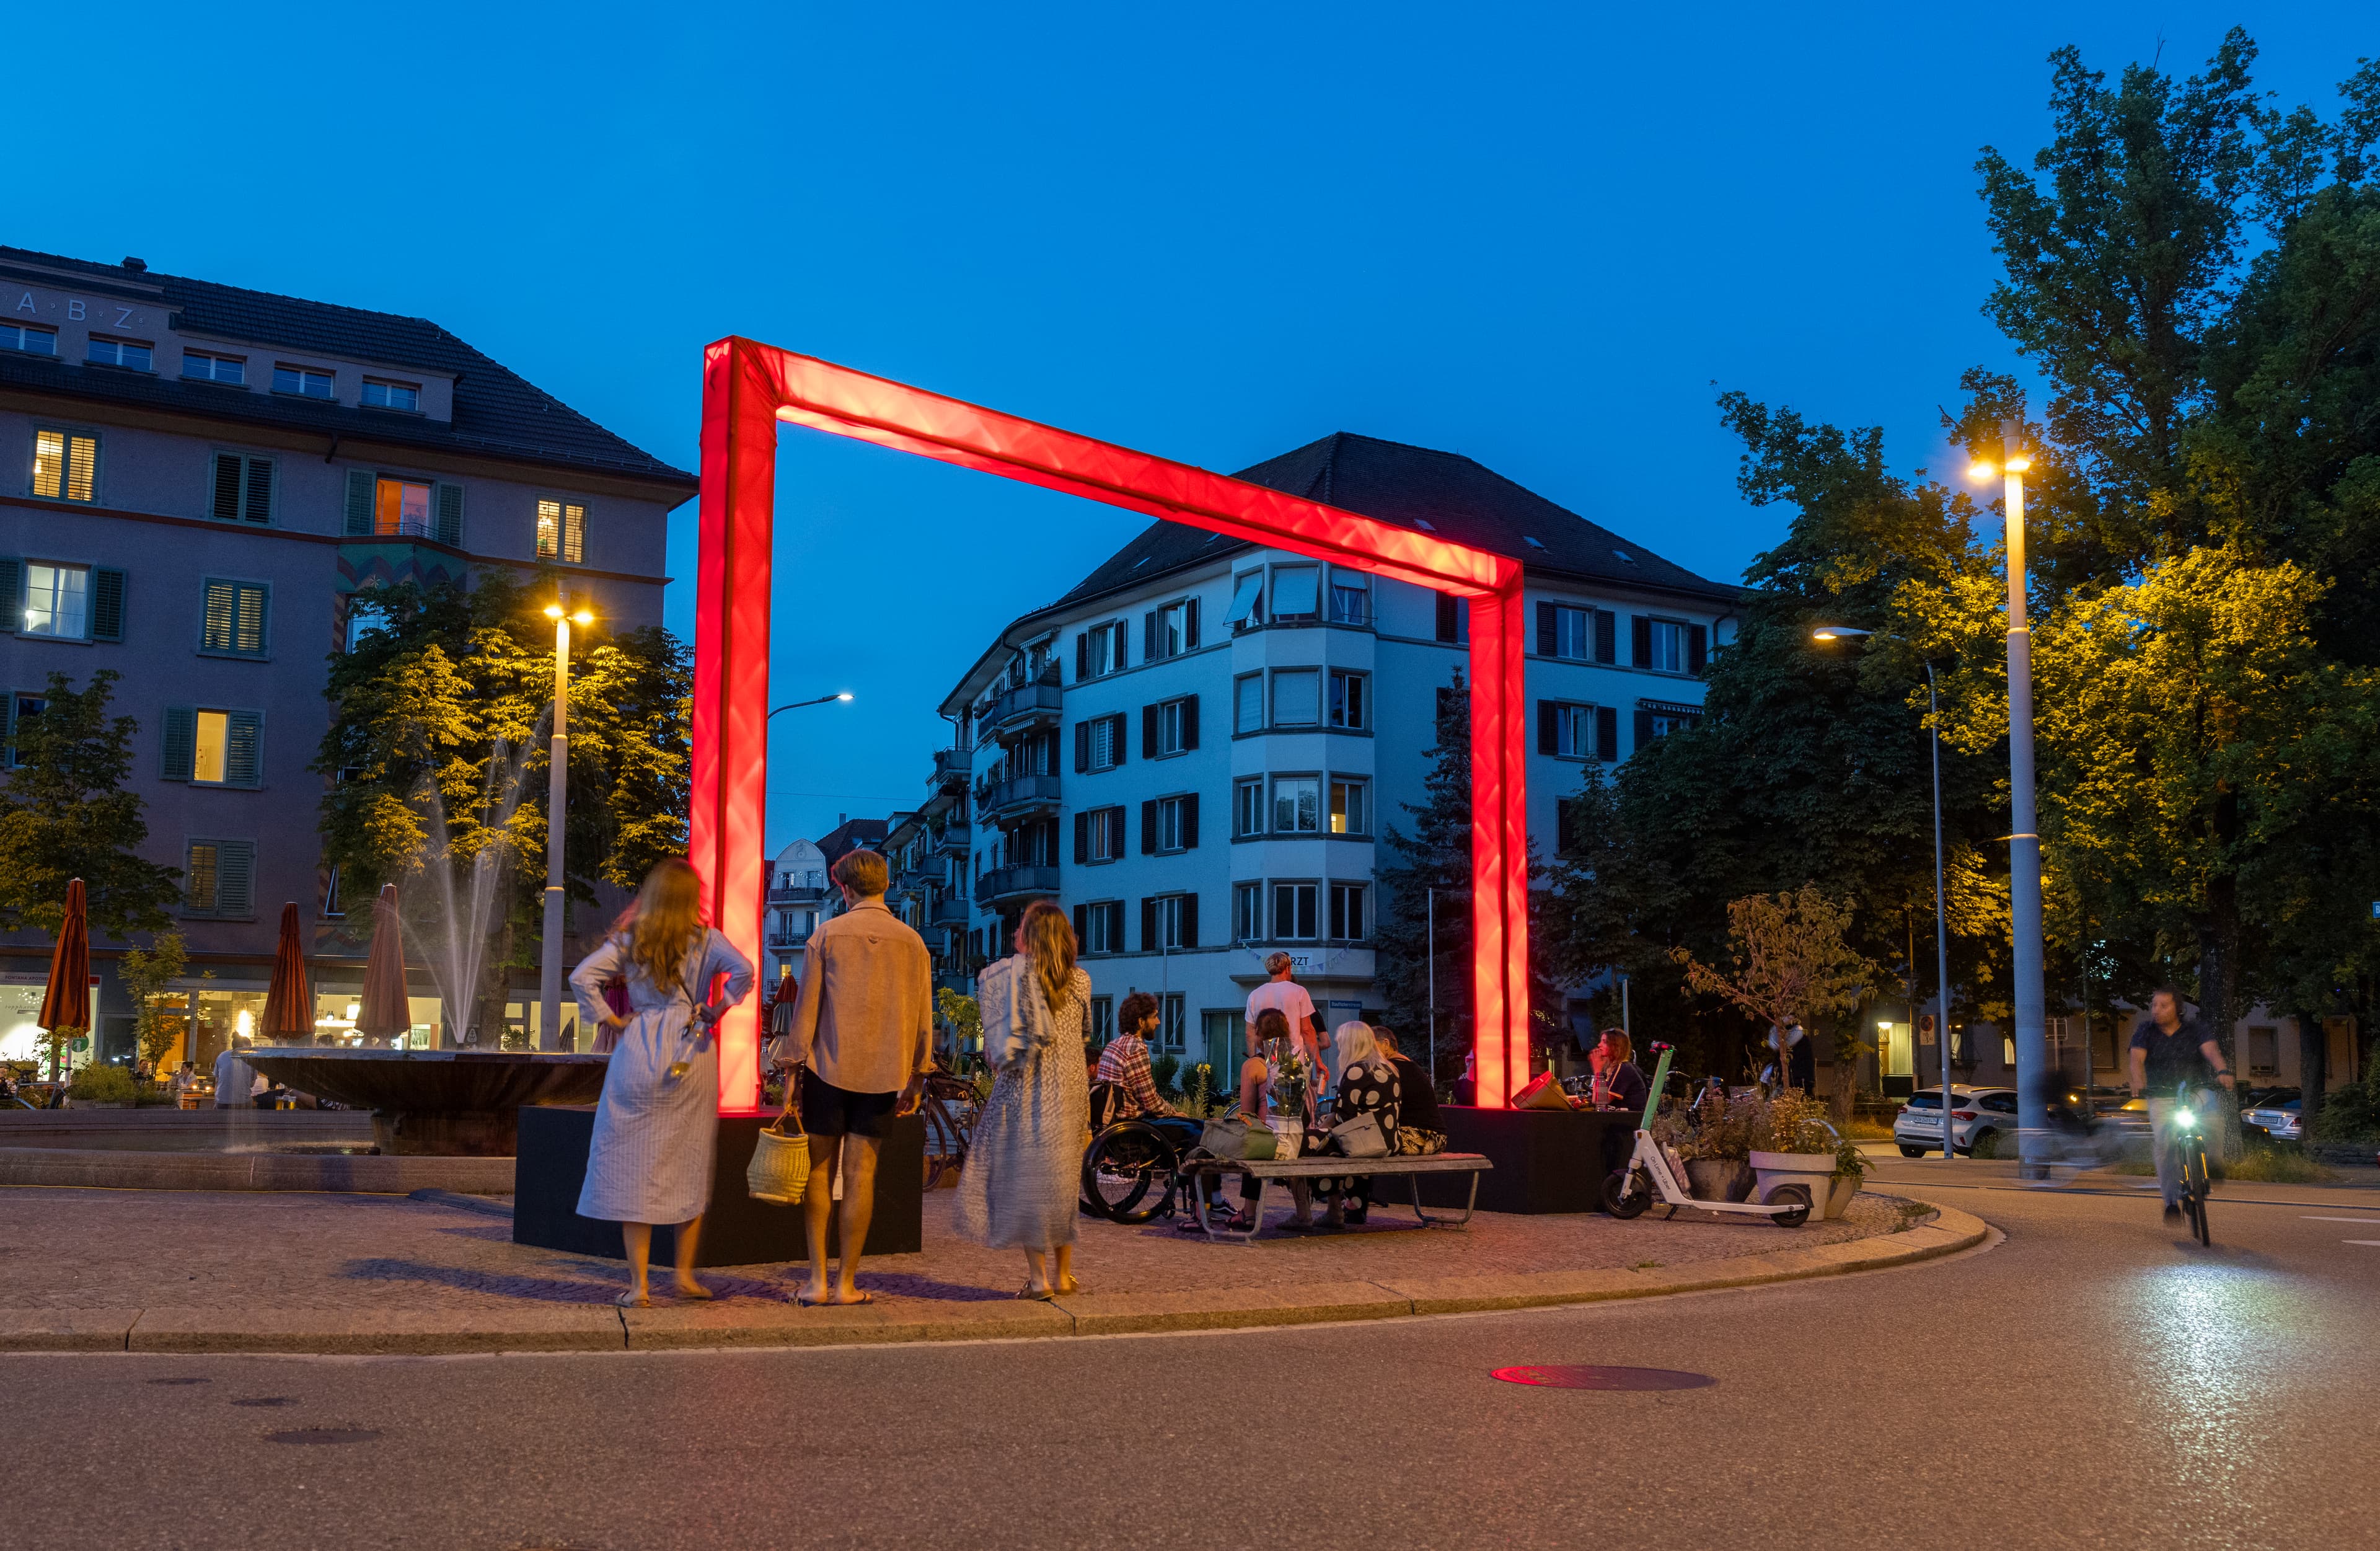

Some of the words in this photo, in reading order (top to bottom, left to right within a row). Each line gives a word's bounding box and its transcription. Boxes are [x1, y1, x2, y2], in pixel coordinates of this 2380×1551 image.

[17, 292, 37, 314] A
[68, 299, 86, 321] B
[113, 307, 134, 329] Z
[1291, 957, 1309, 966] RZT
